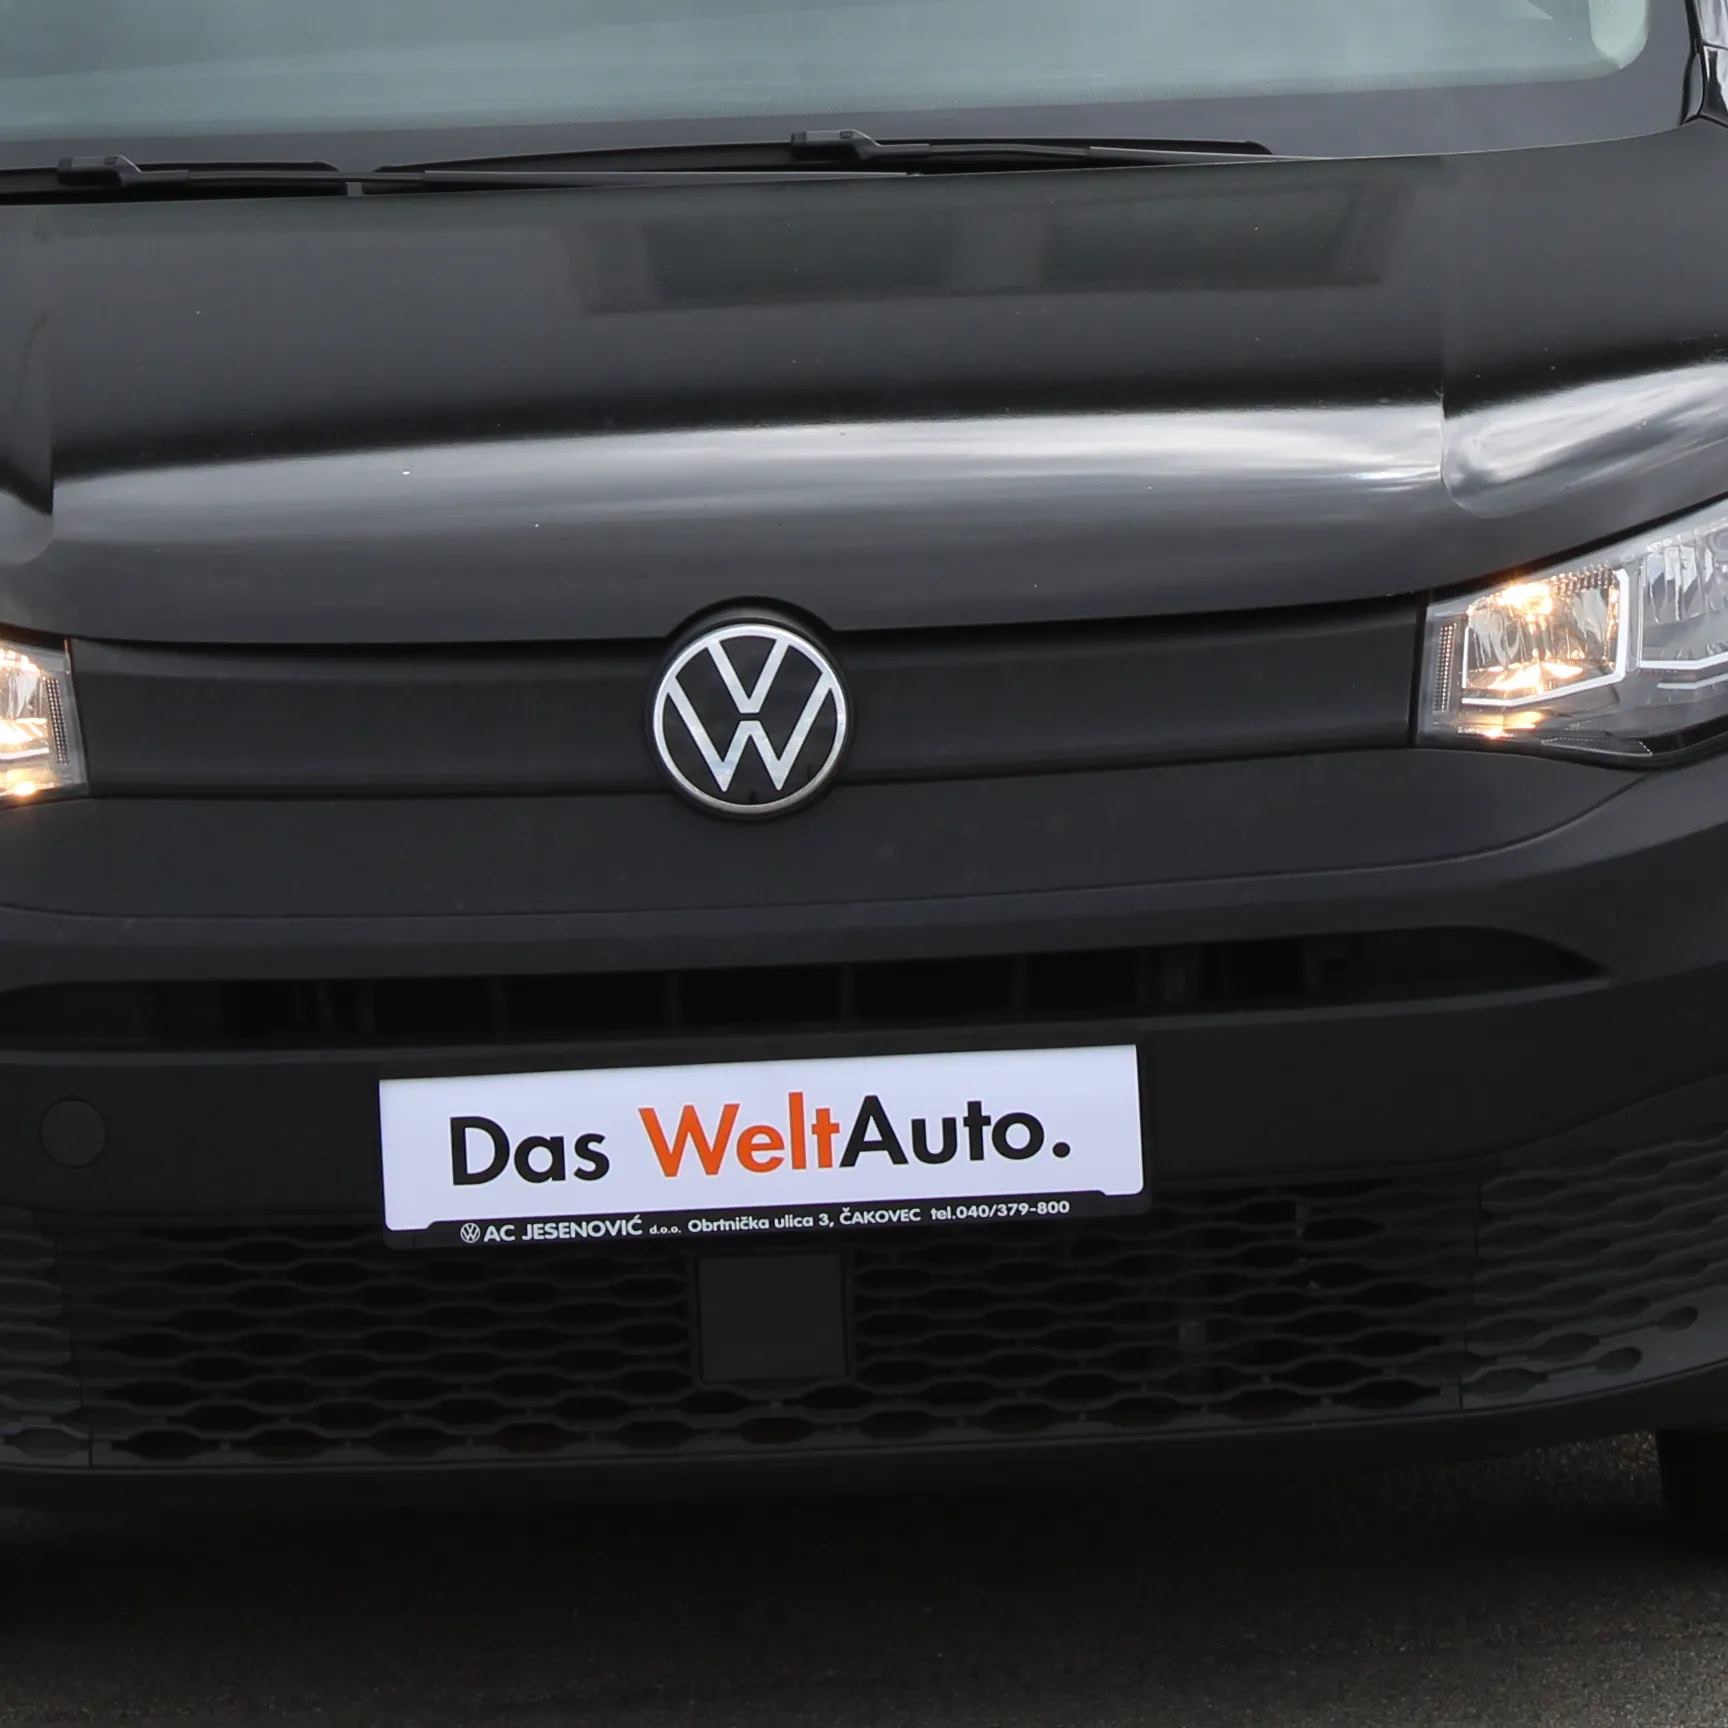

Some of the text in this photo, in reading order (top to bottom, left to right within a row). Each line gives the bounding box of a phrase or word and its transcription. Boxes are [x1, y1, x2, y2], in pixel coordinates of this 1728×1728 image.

[448, 1090, 1072, 1187] Das WeltAuto.
[483, 1224, 516, 1243] AC
[521, 1214, 643, 1241] JESENOVIĆ
[649, 1224, 682, 1235] d.o.o.
[687, 1215, 770, 1233] Obrtnička
[774, 1213, 814, 1229] ulica
[818, 1213, 835, 1229] 3,
[839, 1206, 922, 1225] ČAKOVEC
[930, 1200, 1071, 1220] tel.040/379-800
